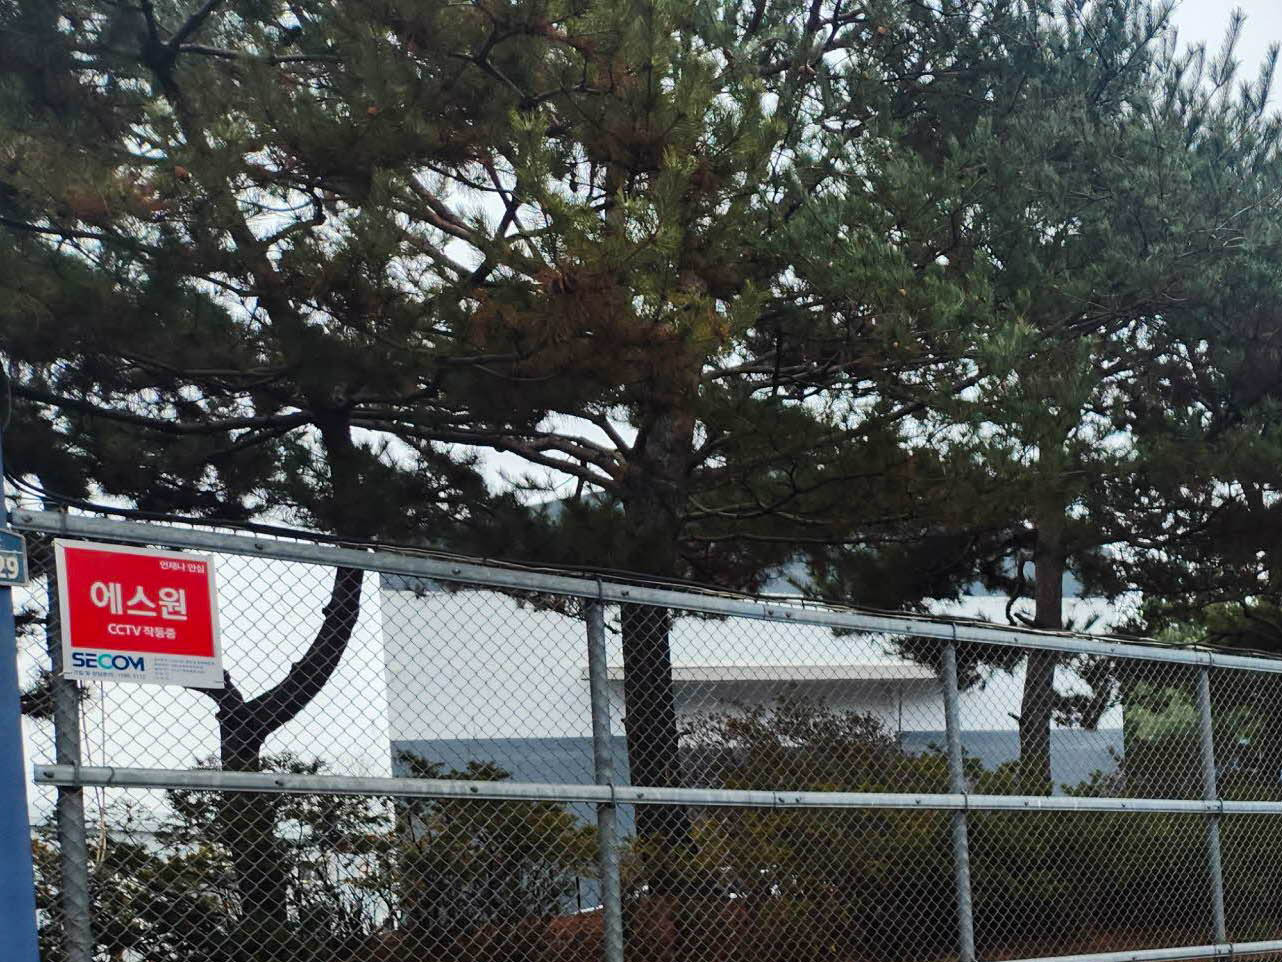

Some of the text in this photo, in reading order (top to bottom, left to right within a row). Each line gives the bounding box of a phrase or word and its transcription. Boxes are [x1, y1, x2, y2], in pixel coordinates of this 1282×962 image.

[90, 581, 187, 621] 에스원
[107, 623, 141, 636] CCTV
[72, 652, 145, 671] SECOM
